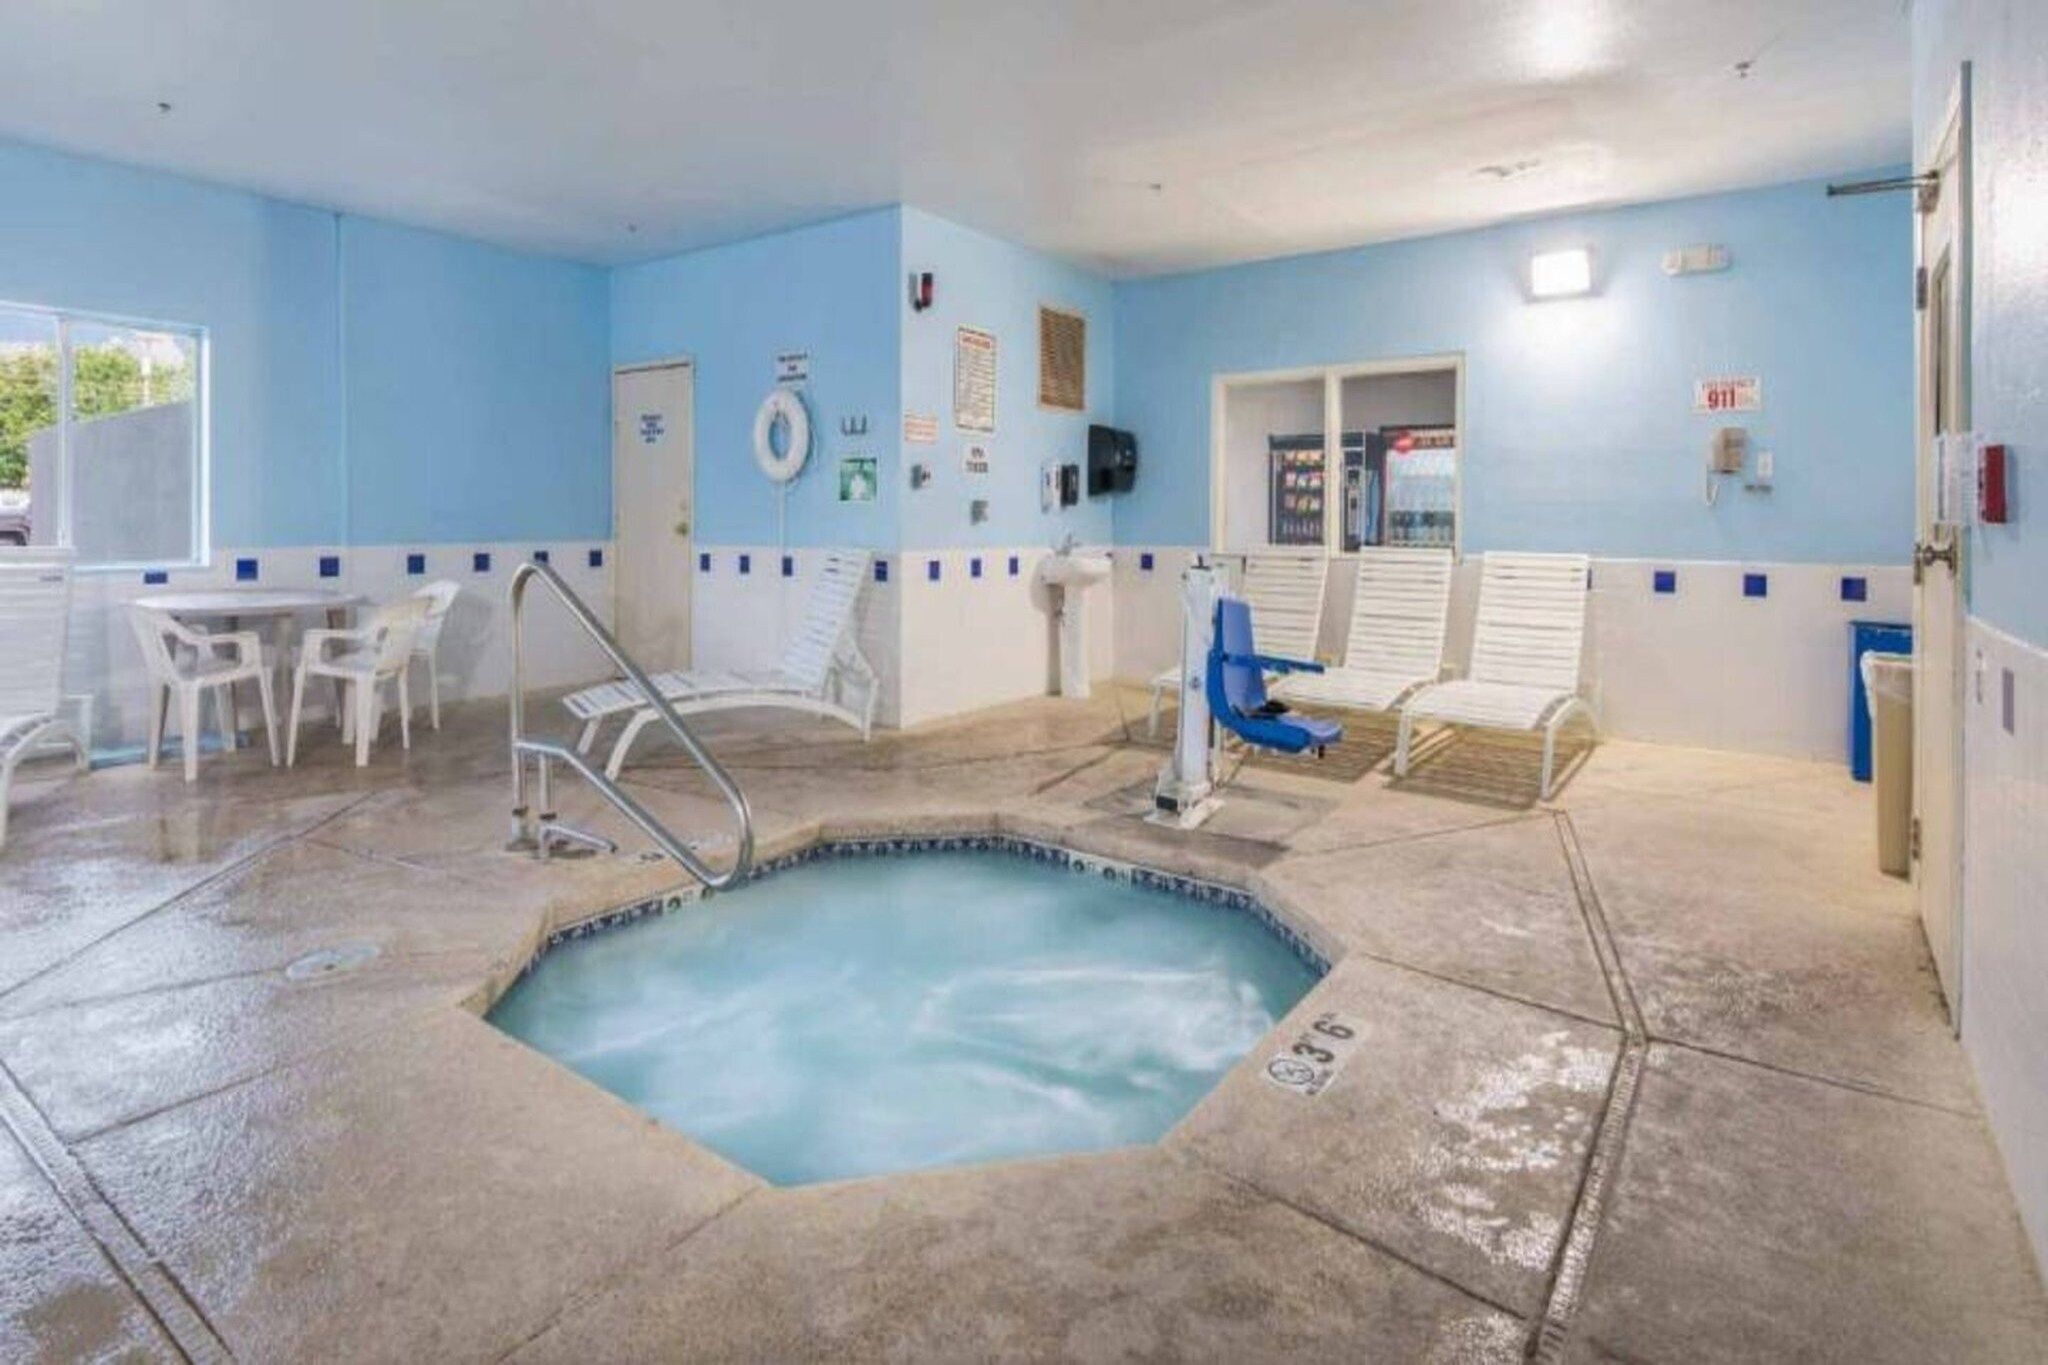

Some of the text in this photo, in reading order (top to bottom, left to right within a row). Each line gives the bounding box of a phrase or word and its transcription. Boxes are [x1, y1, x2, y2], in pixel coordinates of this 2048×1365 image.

[1708, 387, 1735, 410] 911
[1312, 1020, 1354, 1040] 6
[1292, 1042, 1334, 1062] 3
